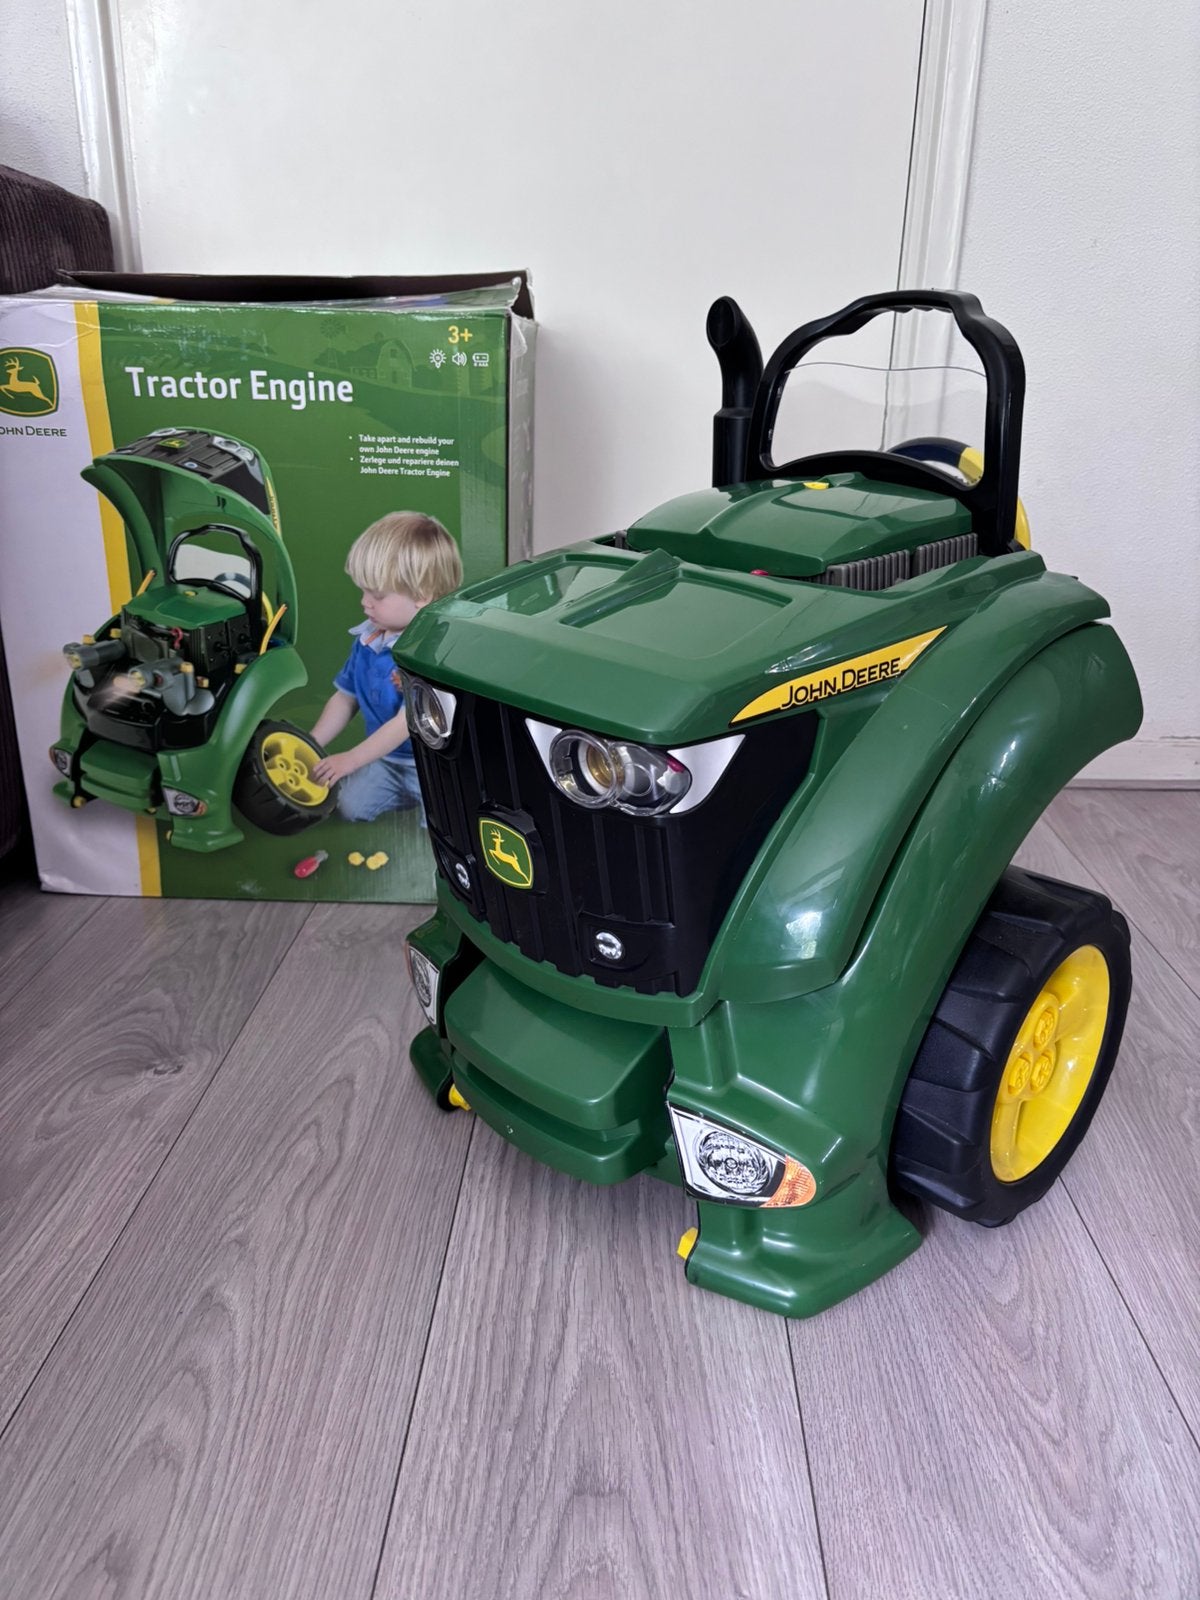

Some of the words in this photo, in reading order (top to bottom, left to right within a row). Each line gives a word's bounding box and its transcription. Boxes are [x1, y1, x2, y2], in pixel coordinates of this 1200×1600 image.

[448, 325, 473, 344] 3+
[125, 366, 241, 399] Tractor
[250, 370, 353, 410] Engine
[0, 426, 24, 435] OHN
[25, 425, 67, 437] DEERE
[359, 434, 376, 442] Take
[377, 436, 397, 445] apart
[398, 435, 411, 443] and
[412, 436, 437, 445] rebuild
[438, 438, 455, 447] your
[376, 445, 393, 454] John
[394, 446, 414, 455] Deere
[415, 448, 440, 456] engine
[360, 455, 386, 465] Zerlege
[387, 457, 401, 465] und
[402, 458, 434, 467] repariere
[435, 458, 459, 467] deinen
[360, 466, 377, 474] John
[378, 466, 399, 475] Deere
[399, 467, 425, 477] Tractor
[426, 468, 451, 479] Engine
[781, 676, 838, 709] JOHN
[841, 657, 901, 691] DEERE
